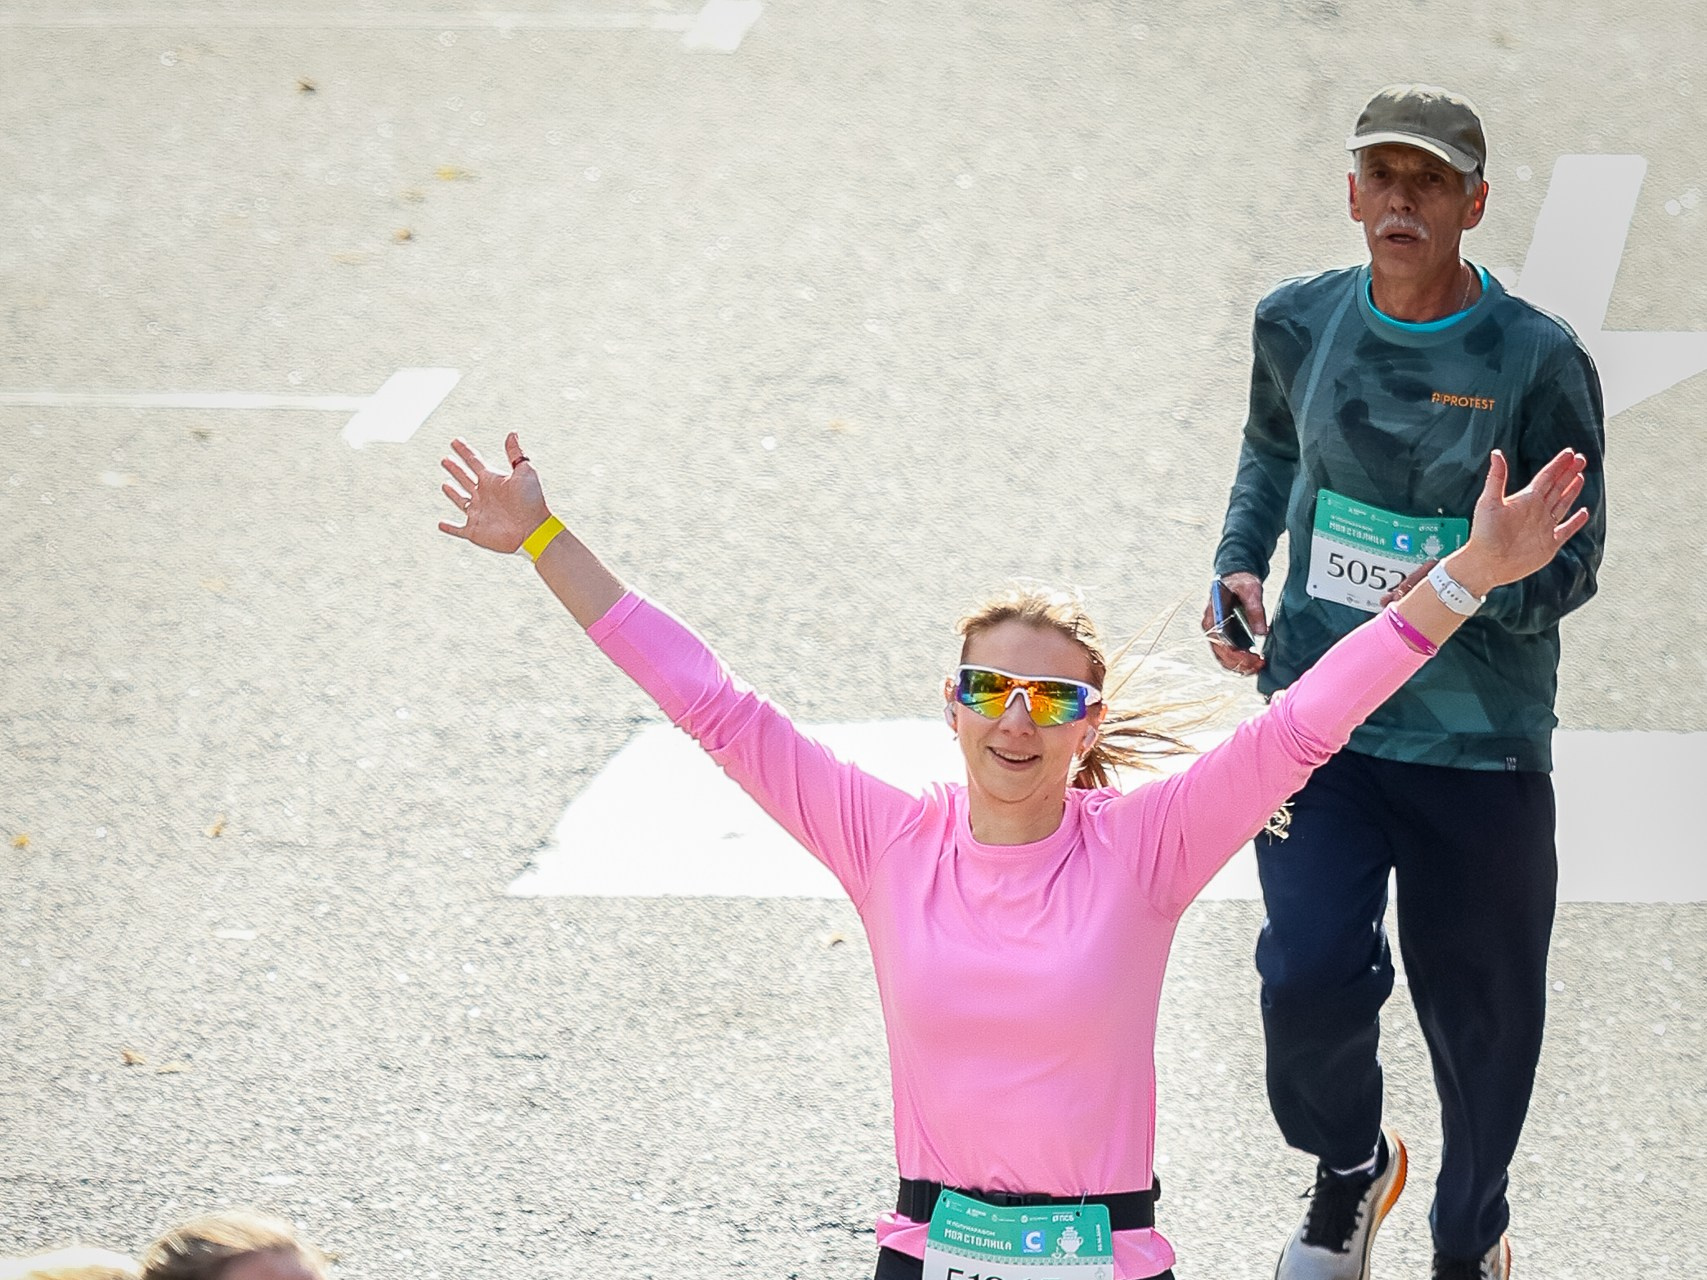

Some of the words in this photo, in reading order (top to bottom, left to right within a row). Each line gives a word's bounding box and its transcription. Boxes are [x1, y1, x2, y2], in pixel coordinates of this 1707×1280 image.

[1442, 394, 1496, 411] PROTEST
[1326, 552, 1407, 592] 5052
[944, 1228, 963, 1242] МОЯ
[963, 1233, 1012, 1251] СТОЛИЦА
